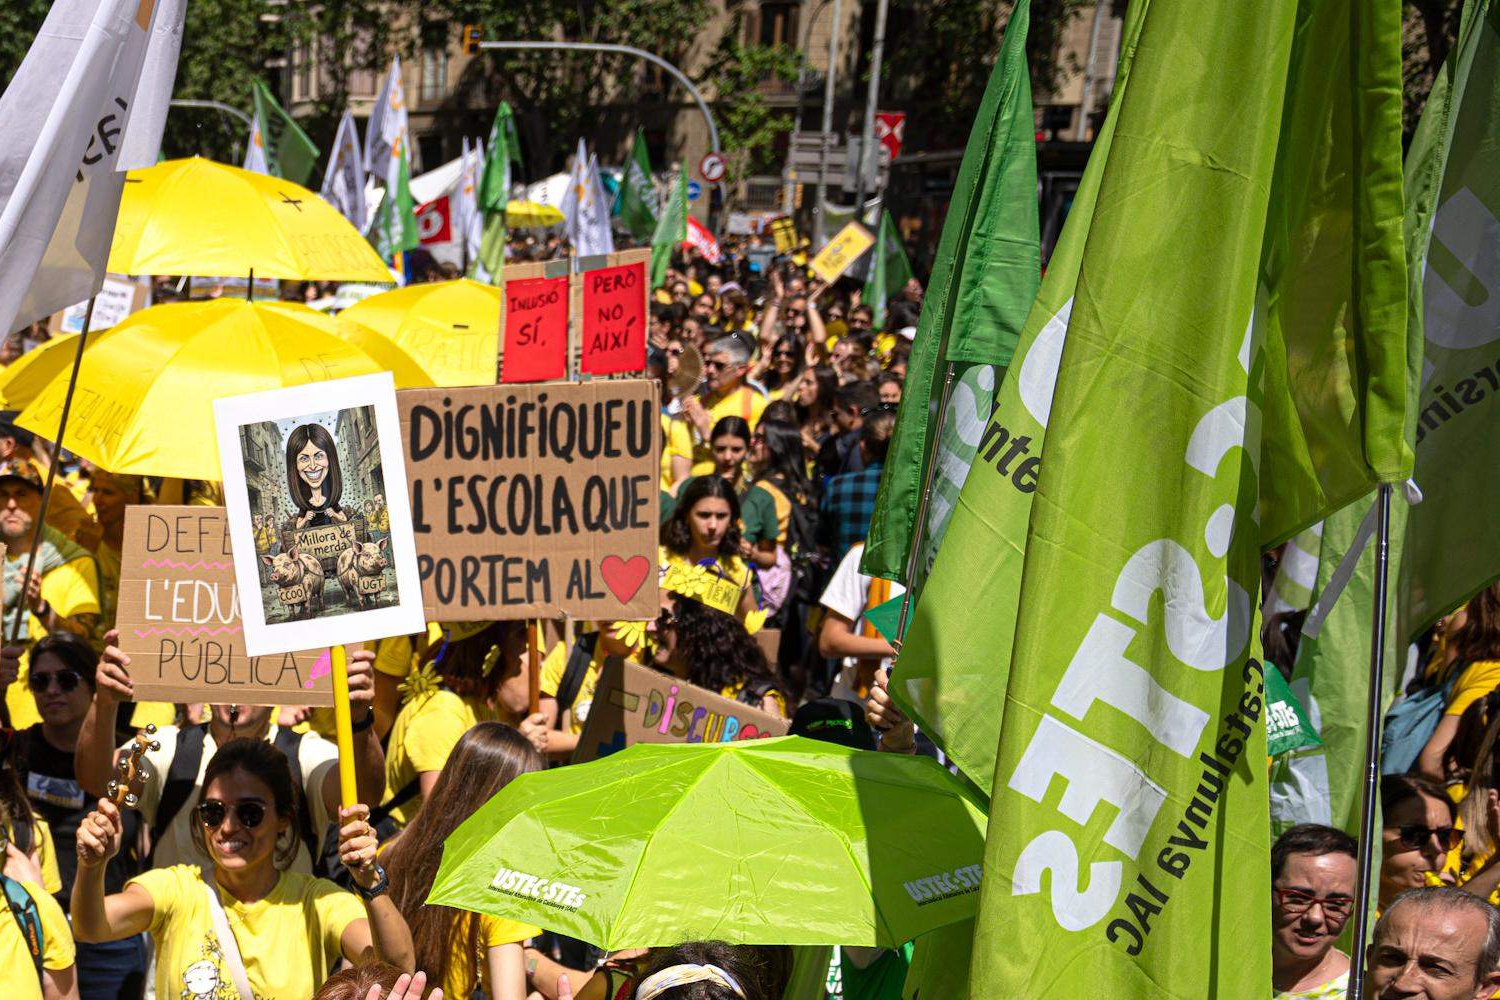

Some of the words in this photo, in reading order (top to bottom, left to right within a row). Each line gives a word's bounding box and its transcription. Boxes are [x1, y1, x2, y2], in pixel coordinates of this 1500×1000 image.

[593, 270, 637, 295] PERÒ
[598, 304, 624, 322] NO
[412, 474, 581, 536] L'ESCOLA
[582, 474, 651, 532] QUE
[313, 540, 349, 555] merda
[362, 577, 383, 592] UGT
[567, 557, 607, 601] AL
[279, 587, 304, 602] CCOO
